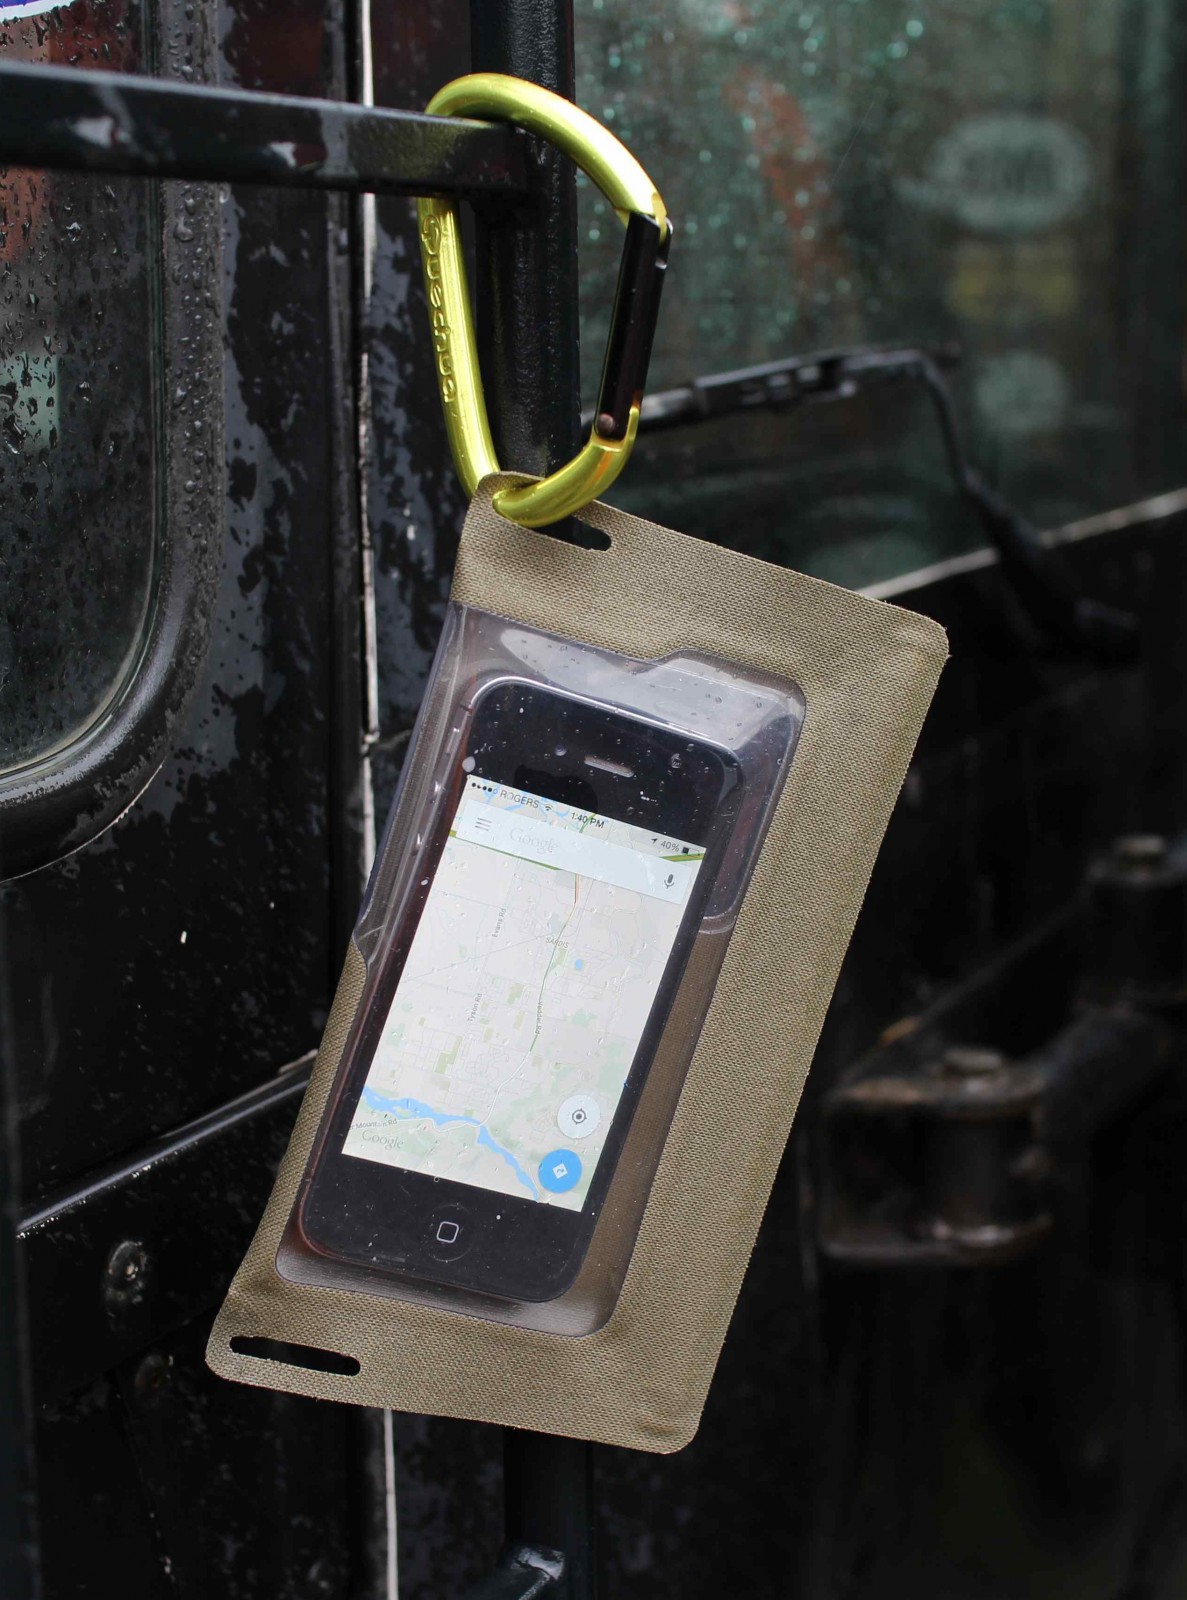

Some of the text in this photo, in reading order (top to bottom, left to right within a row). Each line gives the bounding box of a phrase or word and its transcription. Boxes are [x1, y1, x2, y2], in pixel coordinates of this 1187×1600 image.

[420, 214, 456, 404] Quechua
[499, 789, 540, 810] ROGERS
[571, 812, 605, 829] 1:40 PM
[510, 828, 558, 854] Google
[660, 841, 680, 853] 40%
[492, 918, 504, 938] Evans
[545, 937, 569, 948] SARDIS
[467, 1003, 479, 1022] Tyson
[536, 1001, 544, 1024] Vedder
[362, 1129, 404, 1151] Google
